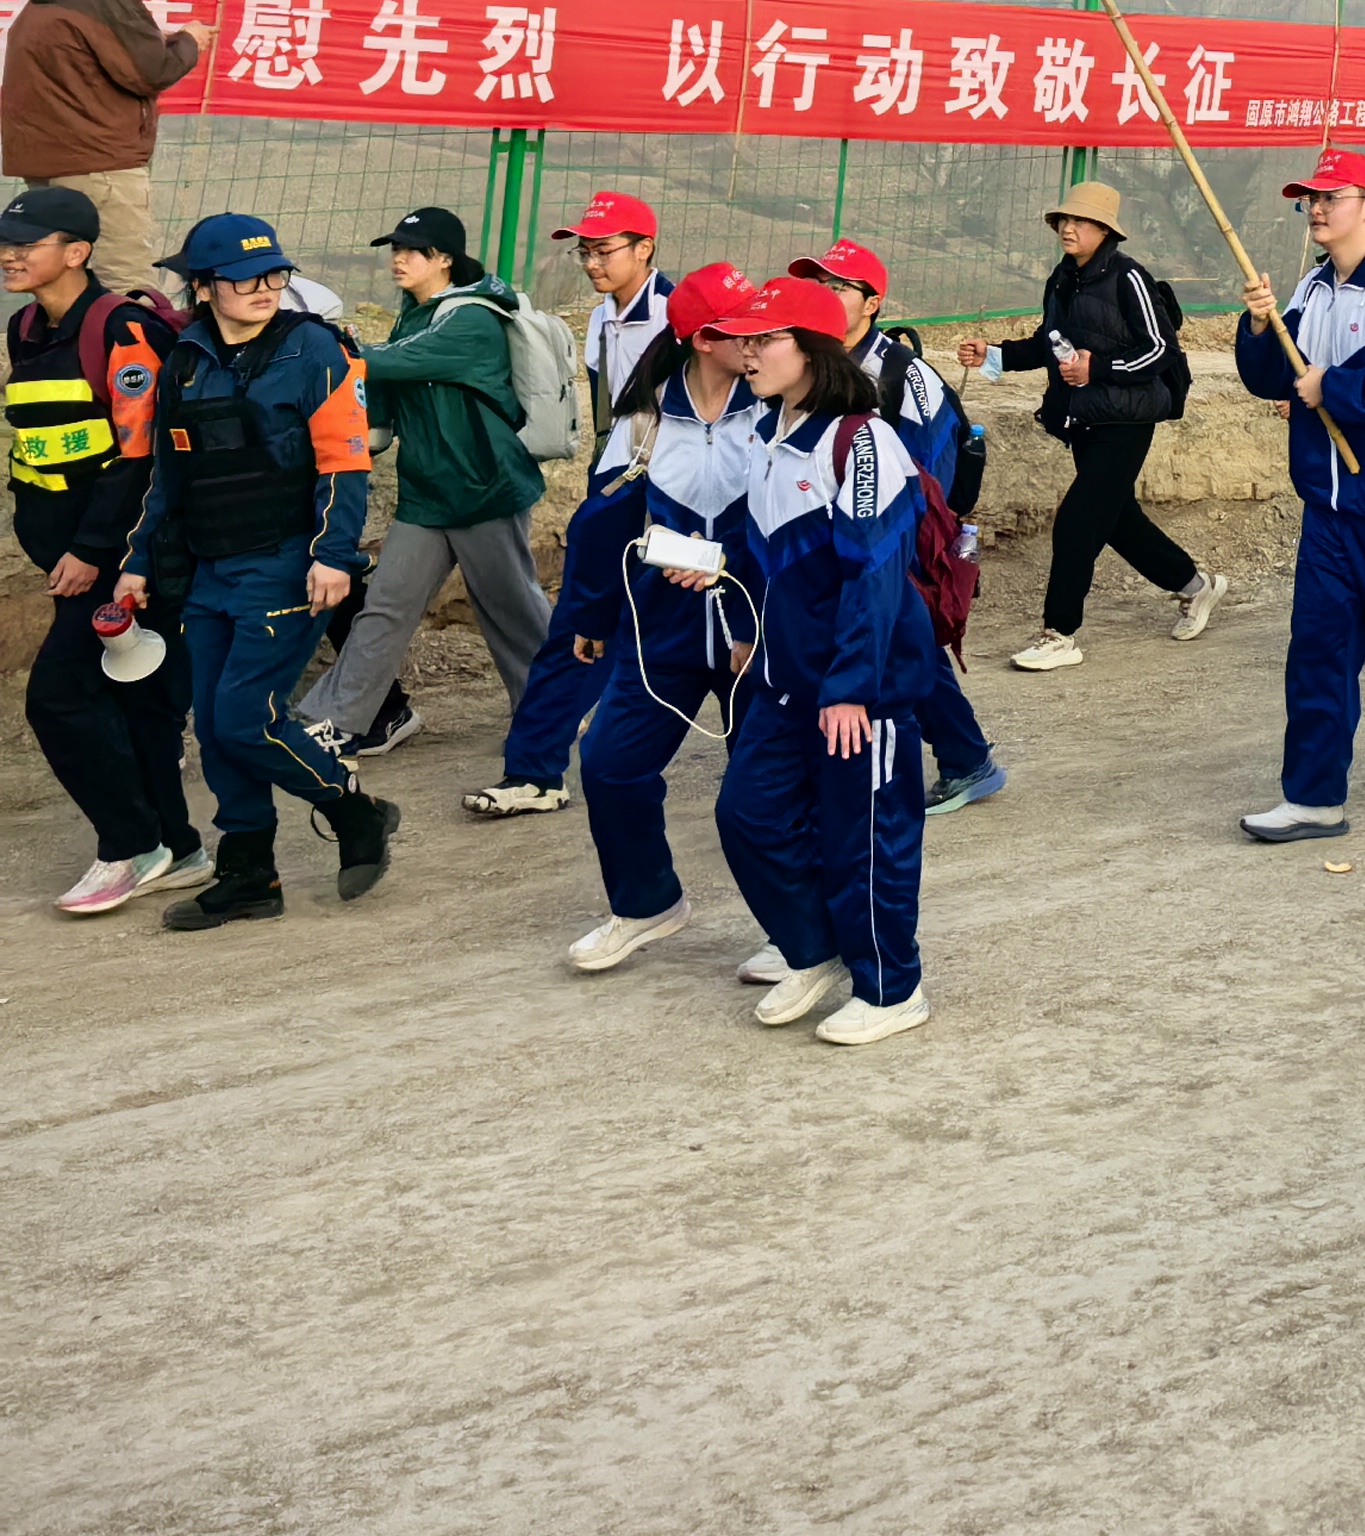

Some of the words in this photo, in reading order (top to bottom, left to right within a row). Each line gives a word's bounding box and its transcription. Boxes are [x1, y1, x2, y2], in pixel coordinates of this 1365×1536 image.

[661, 17, 1236, 126] 以行动致敬长征
